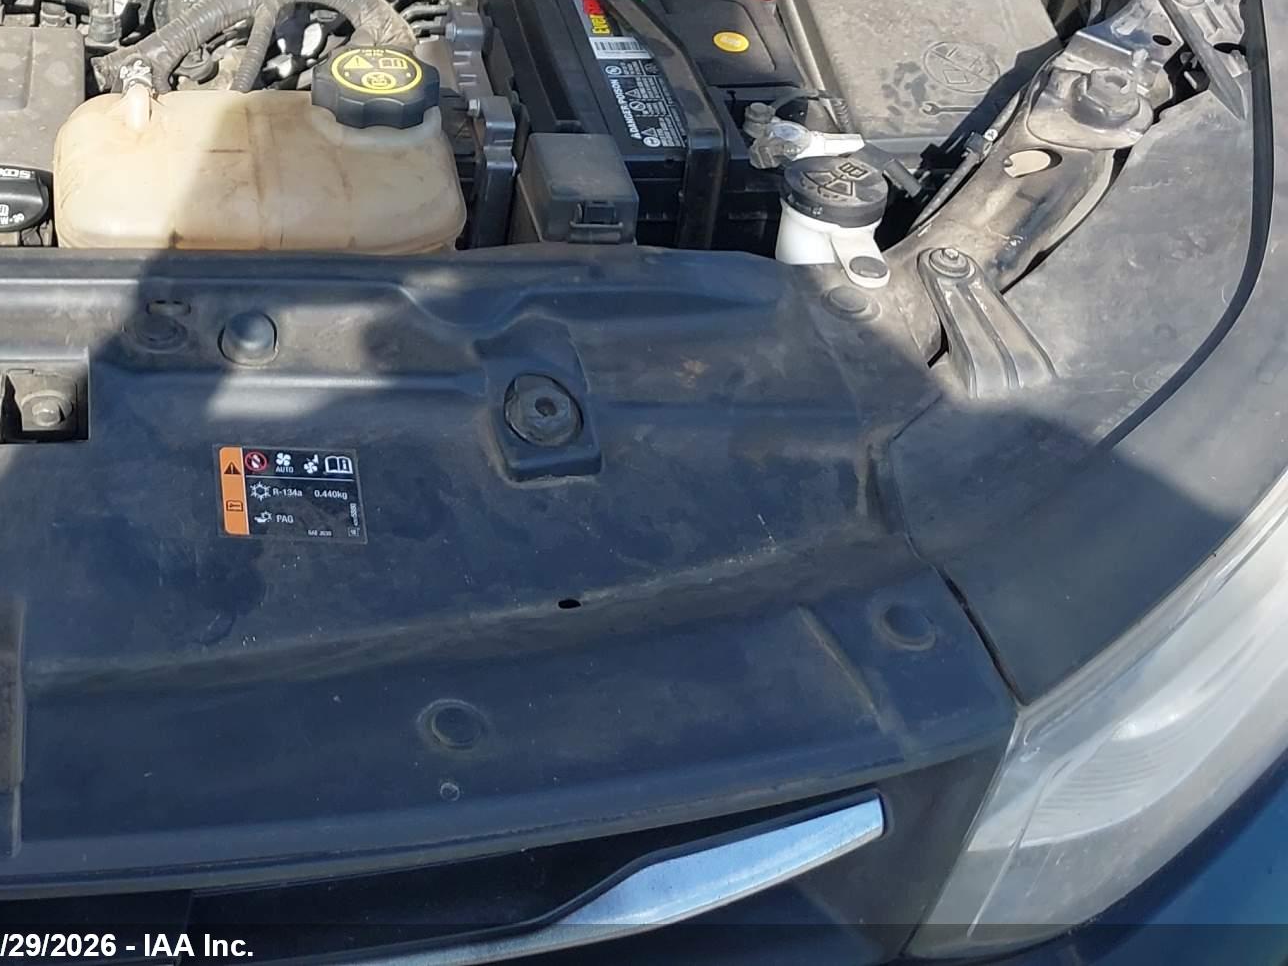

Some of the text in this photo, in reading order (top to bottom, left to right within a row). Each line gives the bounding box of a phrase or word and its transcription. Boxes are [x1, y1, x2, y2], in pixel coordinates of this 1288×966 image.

[272, 488, 348, 500] R-134a 0.440kg
[276, 514, 294, 524] PAG
